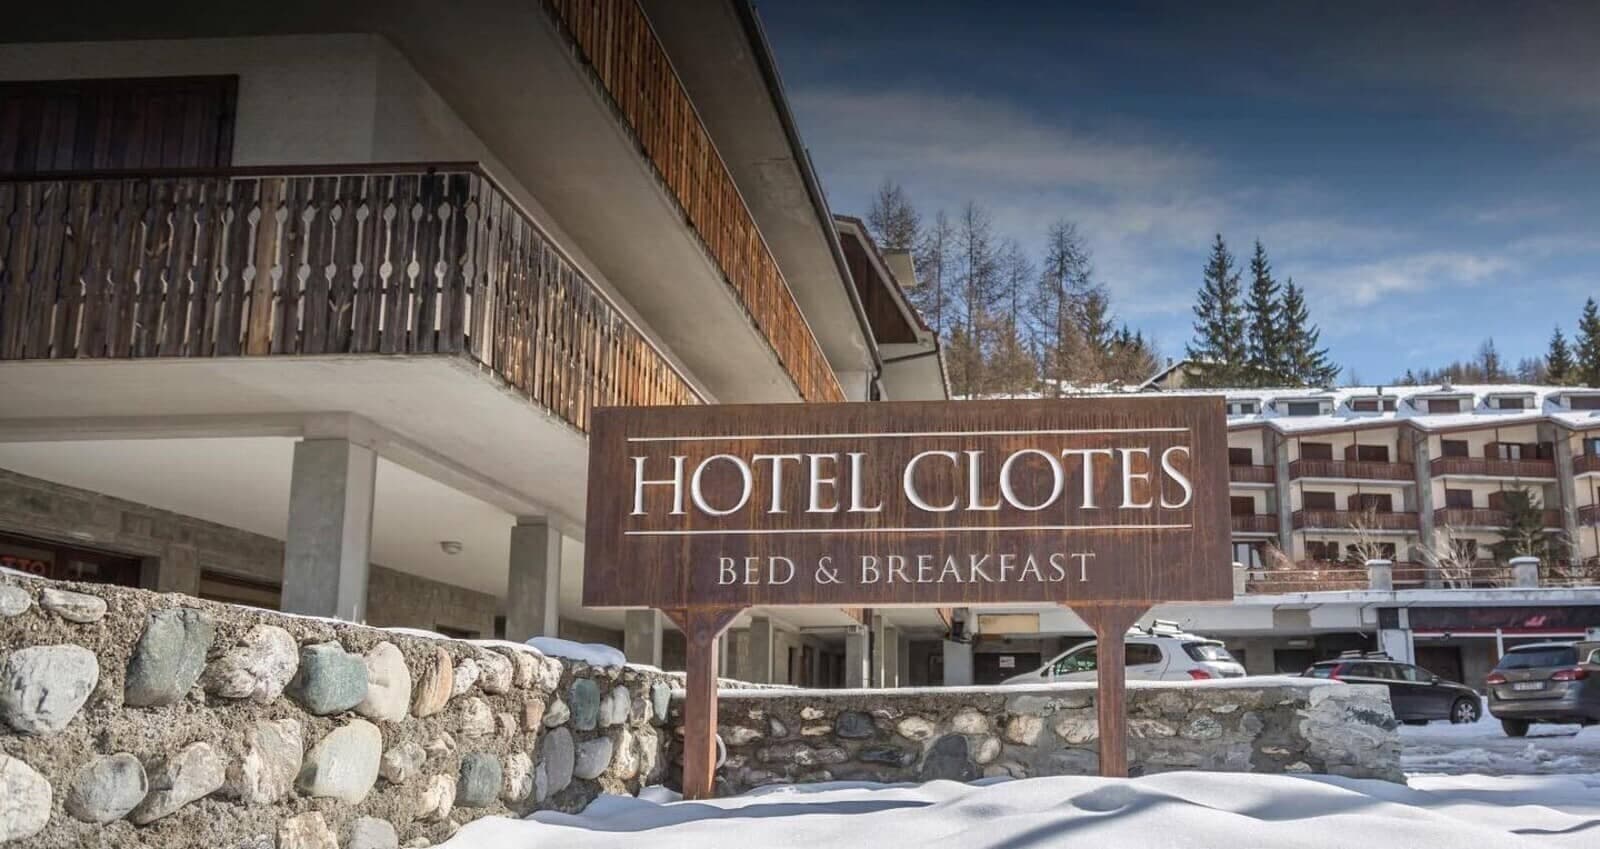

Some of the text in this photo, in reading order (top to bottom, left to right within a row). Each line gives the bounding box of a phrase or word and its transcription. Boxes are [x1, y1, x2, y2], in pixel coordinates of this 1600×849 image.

[630, 445, 1194, 516] HOTEL CLOTES
[718, 552, 1097, 586] BED & BREAKFAST
